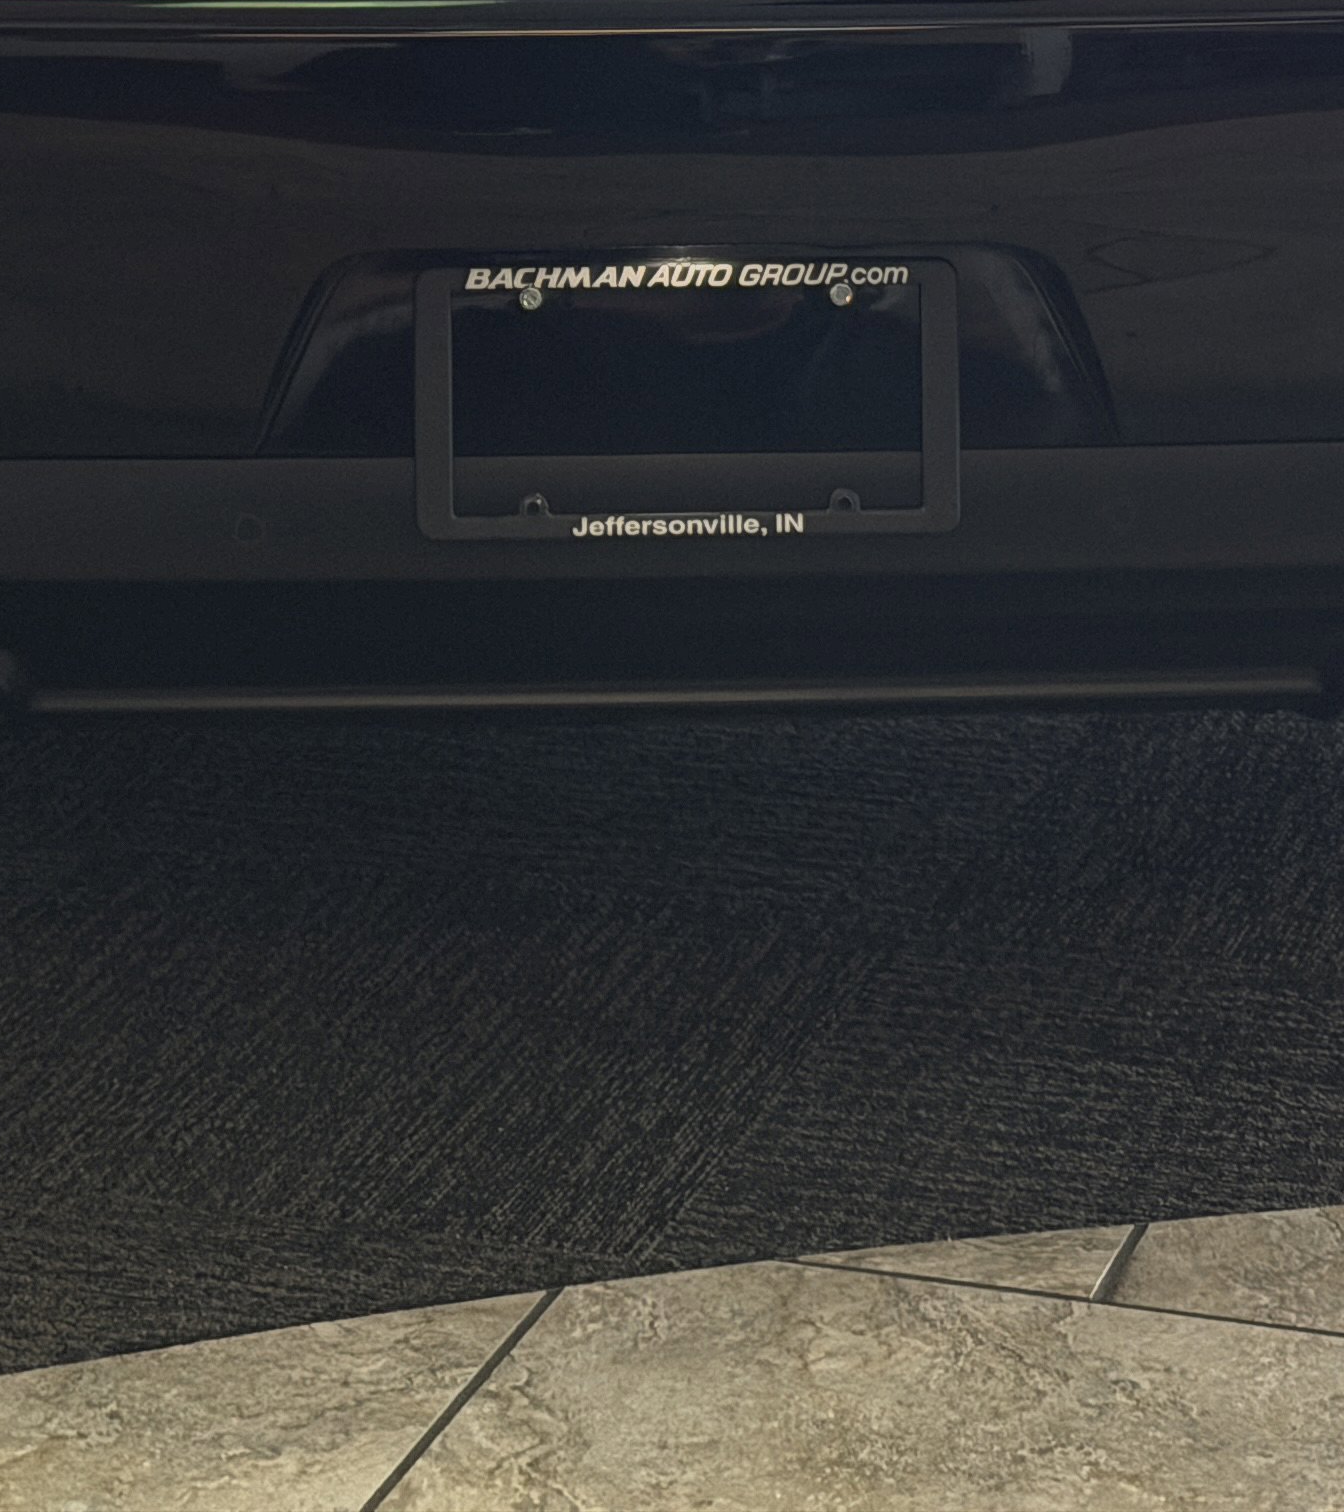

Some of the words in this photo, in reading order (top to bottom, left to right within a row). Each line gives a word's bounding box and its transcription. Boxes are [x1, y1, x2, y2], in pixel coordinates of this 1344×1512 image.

[464, 265, 647, 290] BACHMAN
[647, 263, 733, 287] AUTO
[738, 263, 910, 287] GROUP.com
[572, 514, 768, 537] Jeffersonville,
[775, 513, 804, 533] IN
